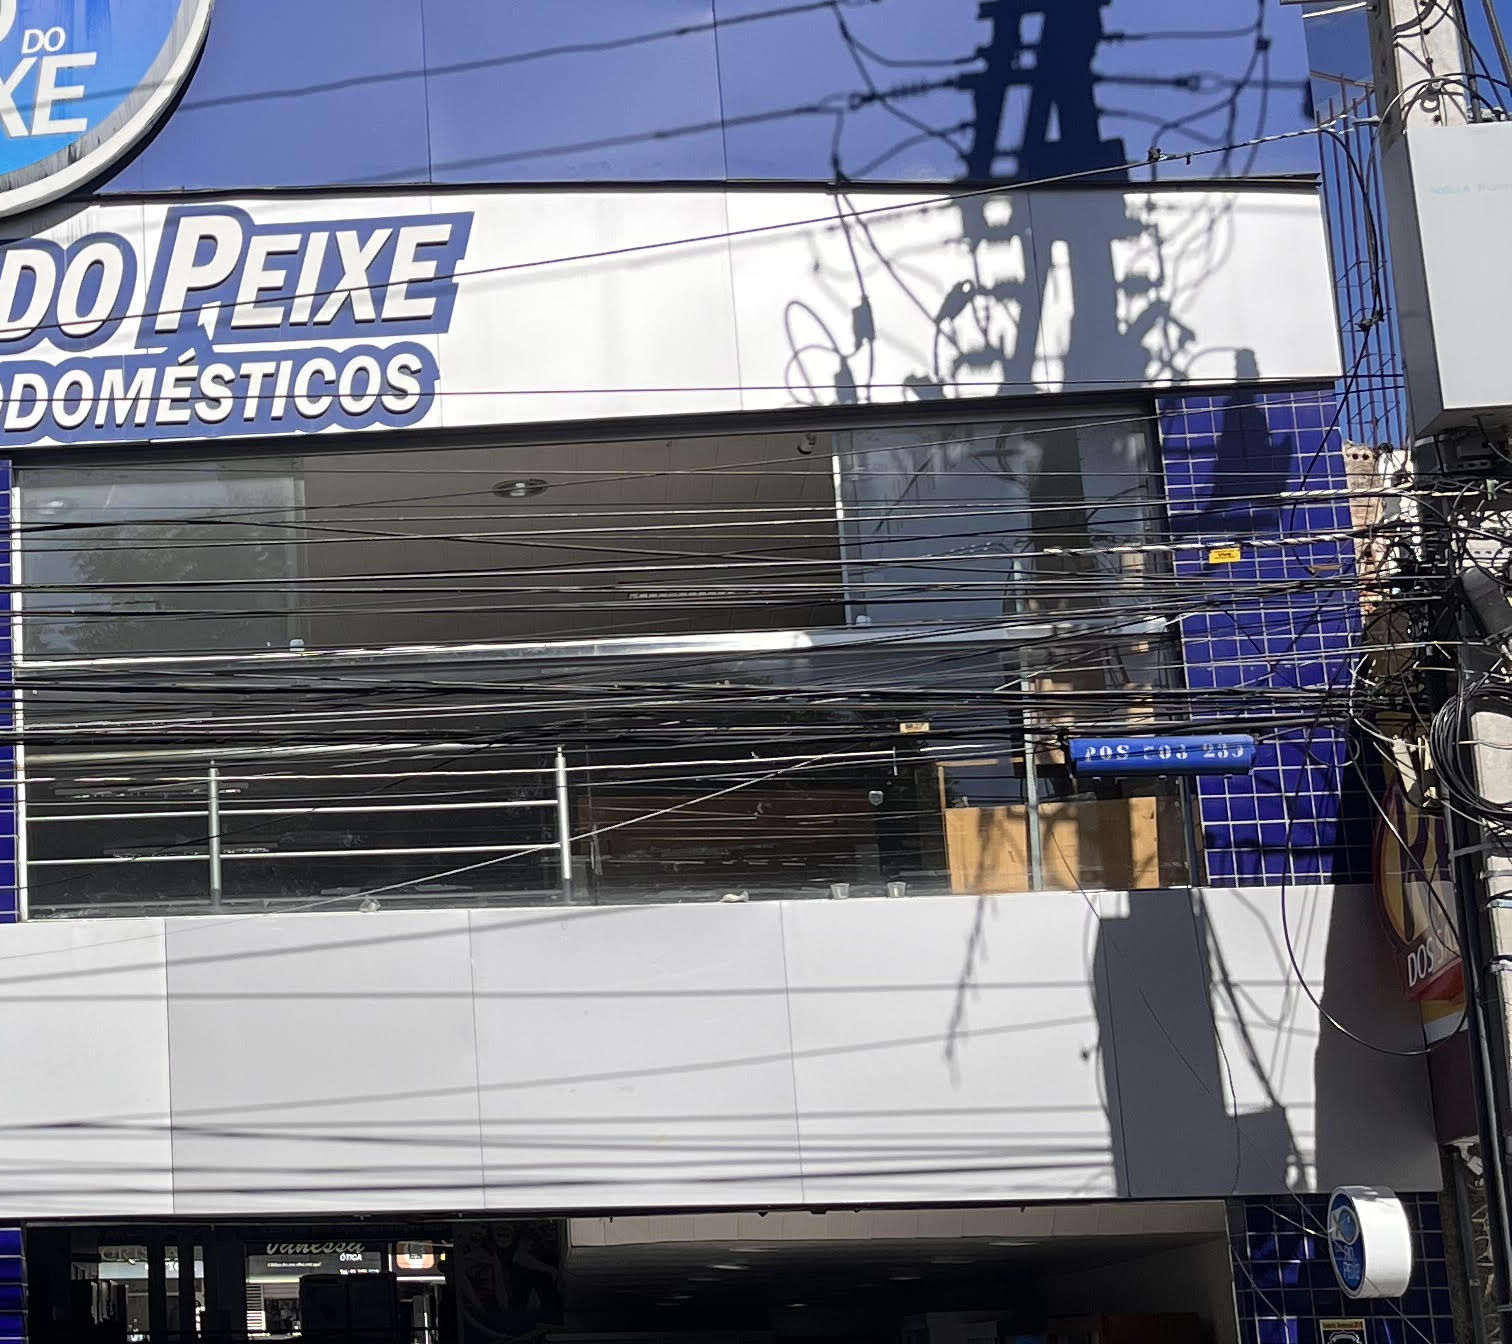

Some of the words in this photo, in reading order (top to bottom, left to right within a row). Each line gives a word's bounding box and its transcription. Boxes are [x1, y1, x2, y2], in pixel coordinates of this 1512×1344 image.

[21, 27, 66, 55] DO
[154, 214, 453, 335] PEIXE
[1406, 936, 1435, 988] DOS
